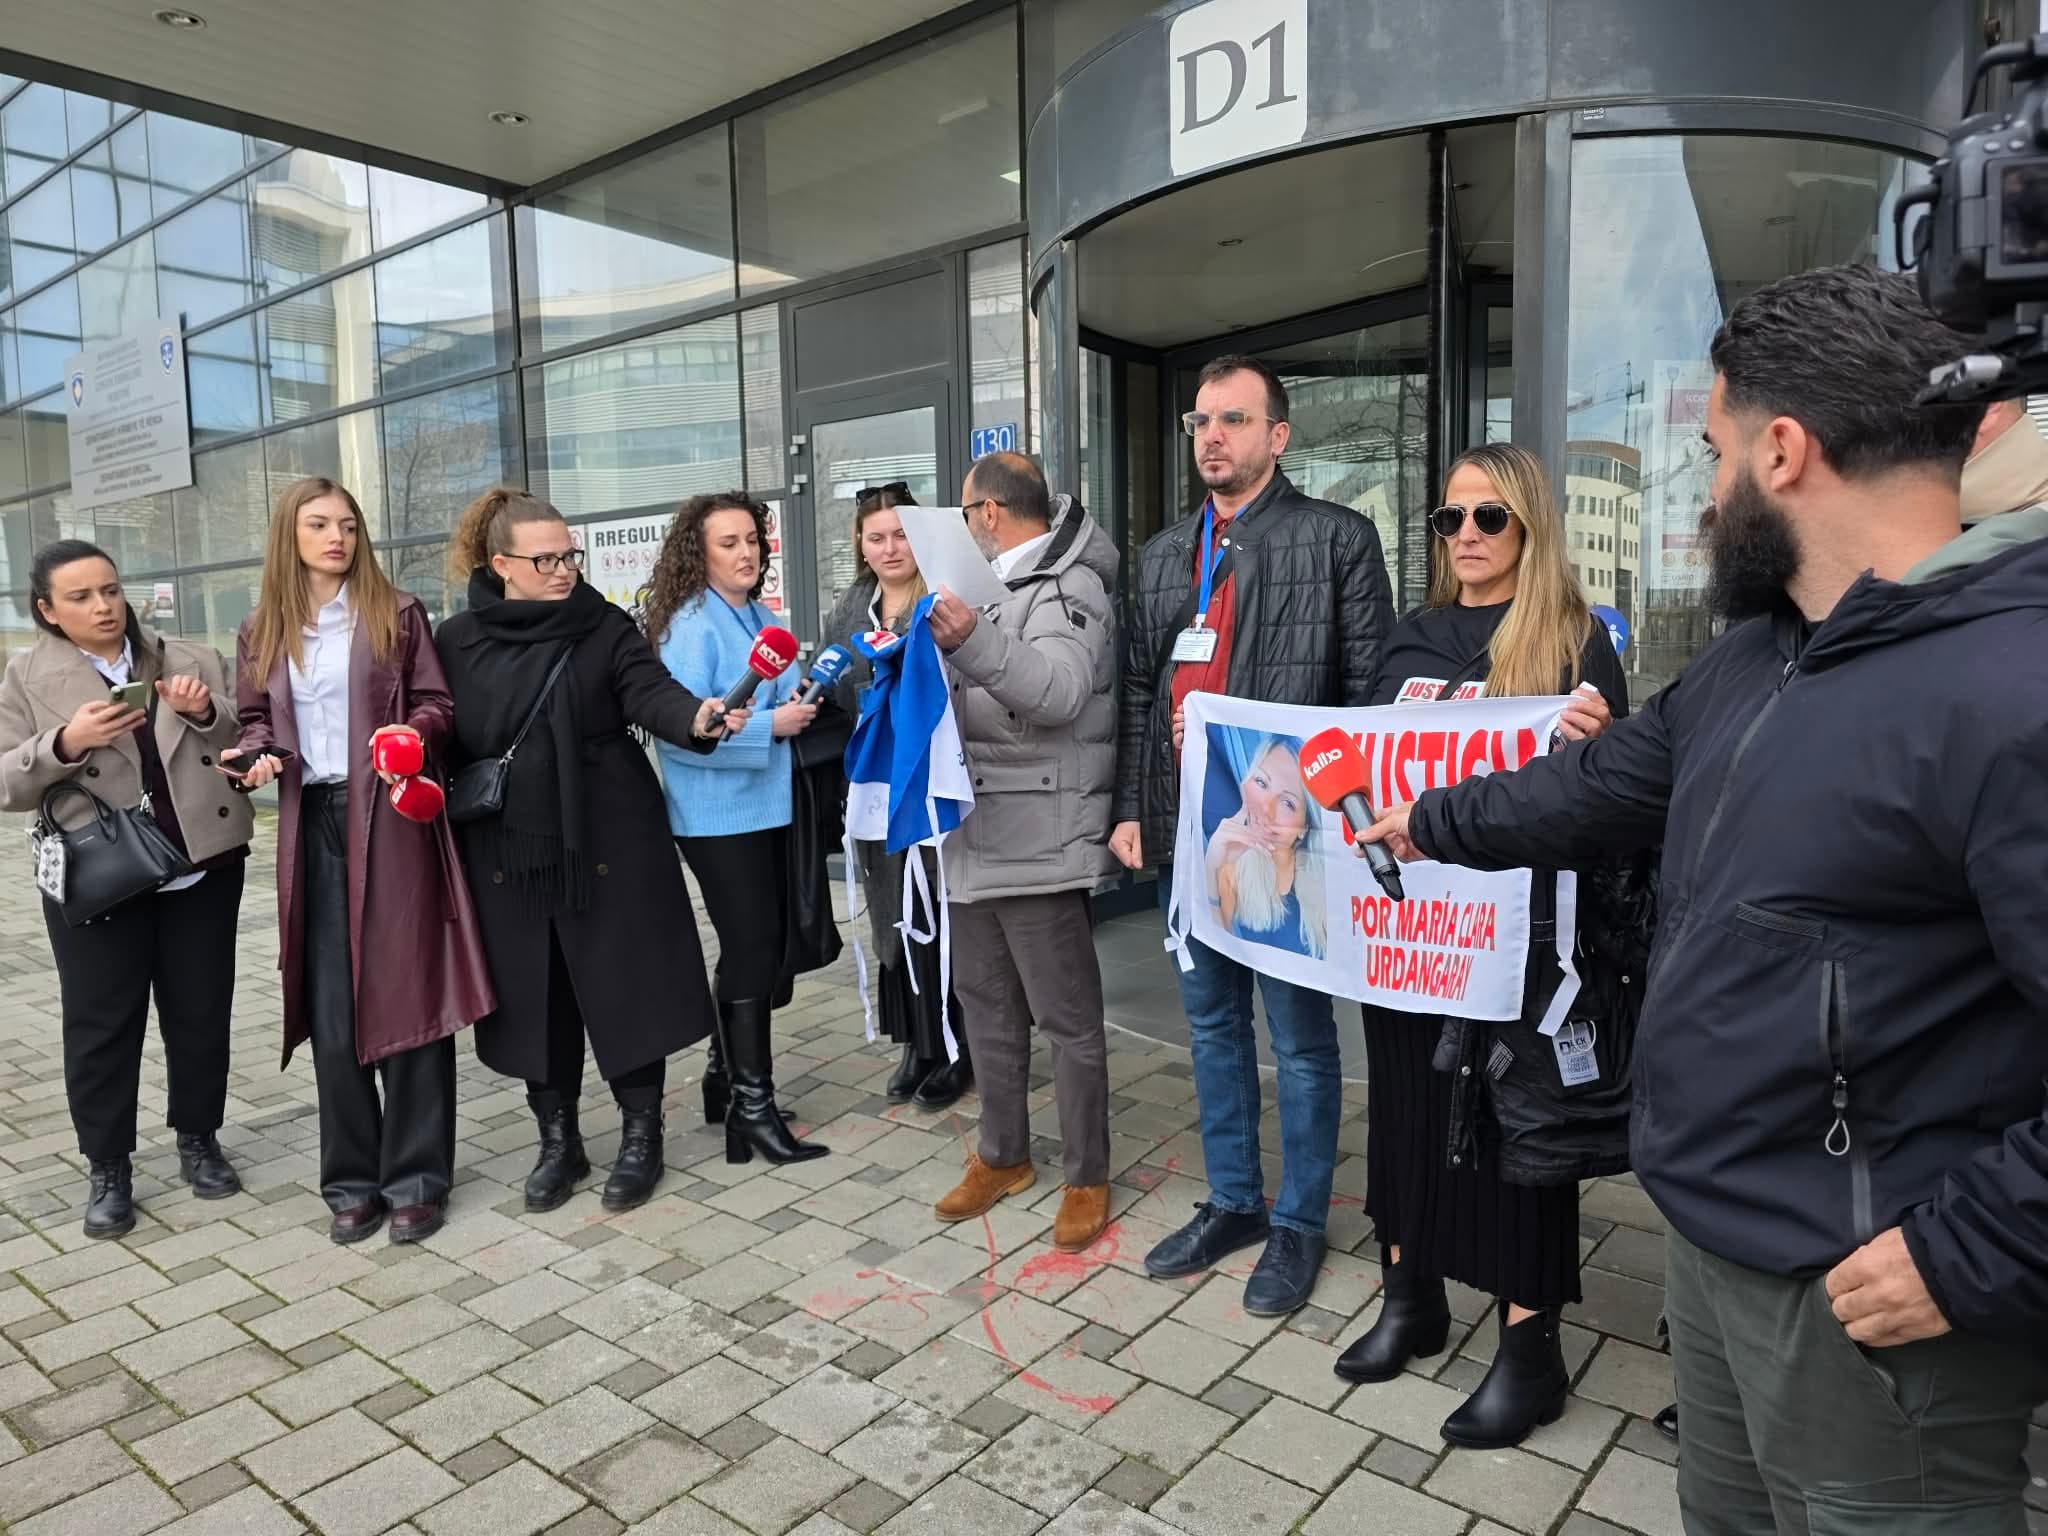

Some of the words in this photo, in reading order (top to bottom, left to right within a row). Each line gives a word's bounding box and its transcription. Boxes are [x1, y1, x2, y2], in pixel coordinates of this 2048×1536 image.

[1177, 20, 1297, 134] D1
[976, 427, 1011, 458] 130
[757, 642, 788, 668] KTV
[1402, 681, 1479, 701] JUSTCIA
[1351, 895, 1392, 940] POR
[1395, 890, 1459, 947] MARÍA
[1457, 901, 1496, 952] CLARA
[1366, 943, 1475, 1001] URDANGARAY
